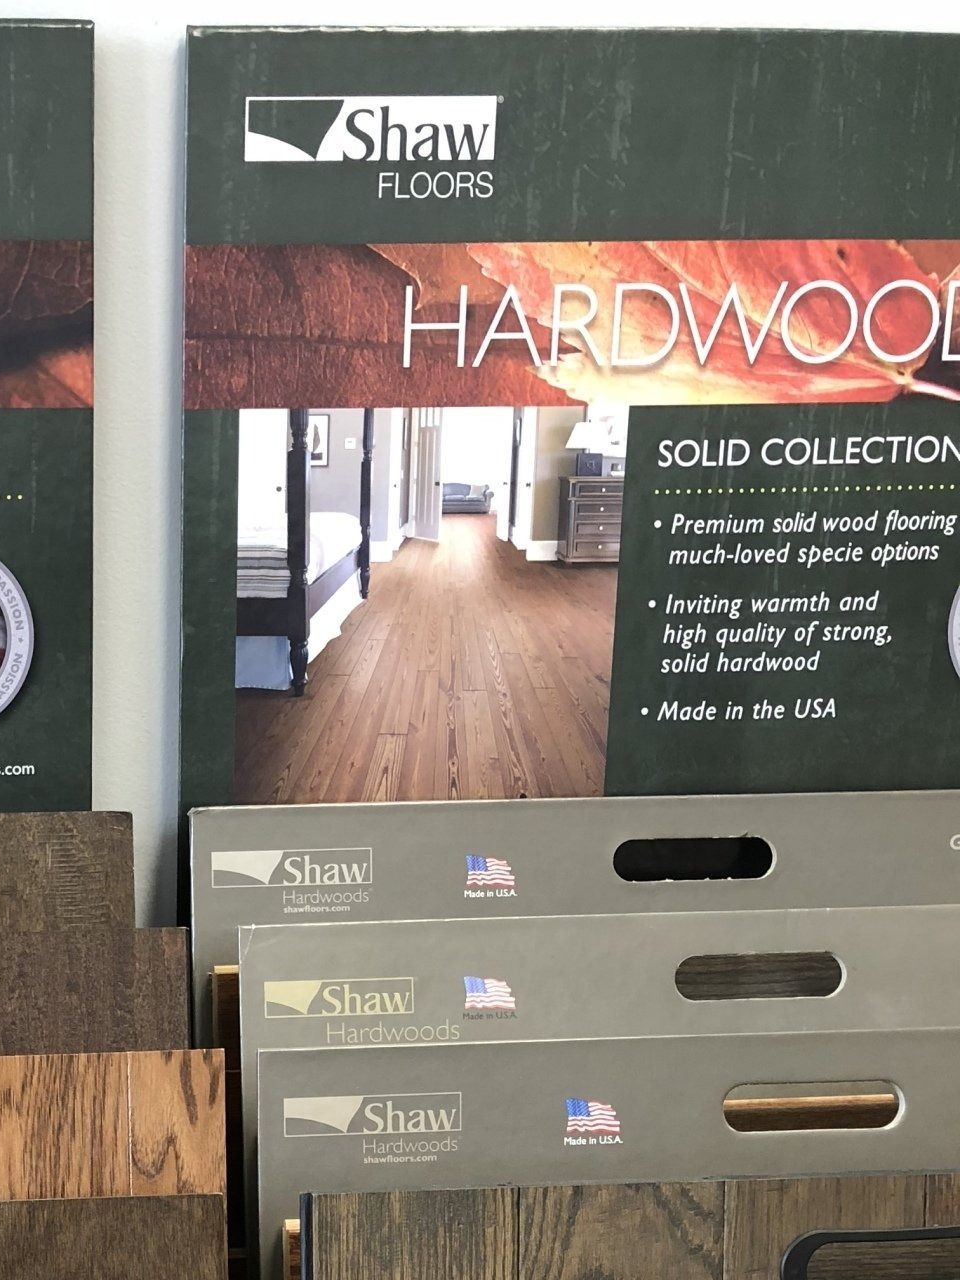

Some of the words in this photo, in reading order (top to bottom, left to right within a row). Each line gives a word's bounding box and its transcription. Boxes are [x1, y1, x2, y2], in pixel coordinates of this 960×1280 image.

[342, 106, 489, 161] Shaw
[378, 171, 494, 199] FLOORS
[402, 279, 960, 369] HARDWOO
[657, 438, 751, 468] SOLID
[760, 435, 960, 466] COLLECTION
[670, 513, 765, 535] Premium
[772, 510, 818, 534] solid
[822, 509, 879, 532] wood
[883, 509, 958, 536] flooring
[668, 541, 791, 565] much-loved
[797, 541, 864, 569] specie
[870, 540, 940, 568] options
[665, 593, 743, 620] Inviting
[751, 590, 830, 613] warmth
[839, 589, 880, 612] and
[662, 622, 707, 650] high
[715, 621, 787, 650] quality
[794, 620, 820, 647] of
[822, 623, 892, 647] strong,
[660, 651, 710, 674] solid
[716, 649, 821, 673] hardwood
[656, 700, 717, 722] Made
[725, 700, 744, 720] in
[752, 699, 786, 720] the
[794, 697, 836, 719] USA
[283, 856, 368, 885] Shaw
[283, 889, 369, 904] Hardwoods
[464, 890, 484, 898] Made
[486, 889, 494, 897] in
[283, 905, 351, 913] shawfloors.com
[322, 984, 410, 1016] Shaw
[463, 1012, 484, 1020] Made
[327, 1019, 460, 1043] Hardwoods
[363, 1101, 457, 1133] Shaw
[363, 1137, 458, 1154] Hardwoods
[563, 1136, 587, 1146] Made
[589, 1136, 597, 1145] in
[363, 1154, 438, 1164] shawfloors.com
